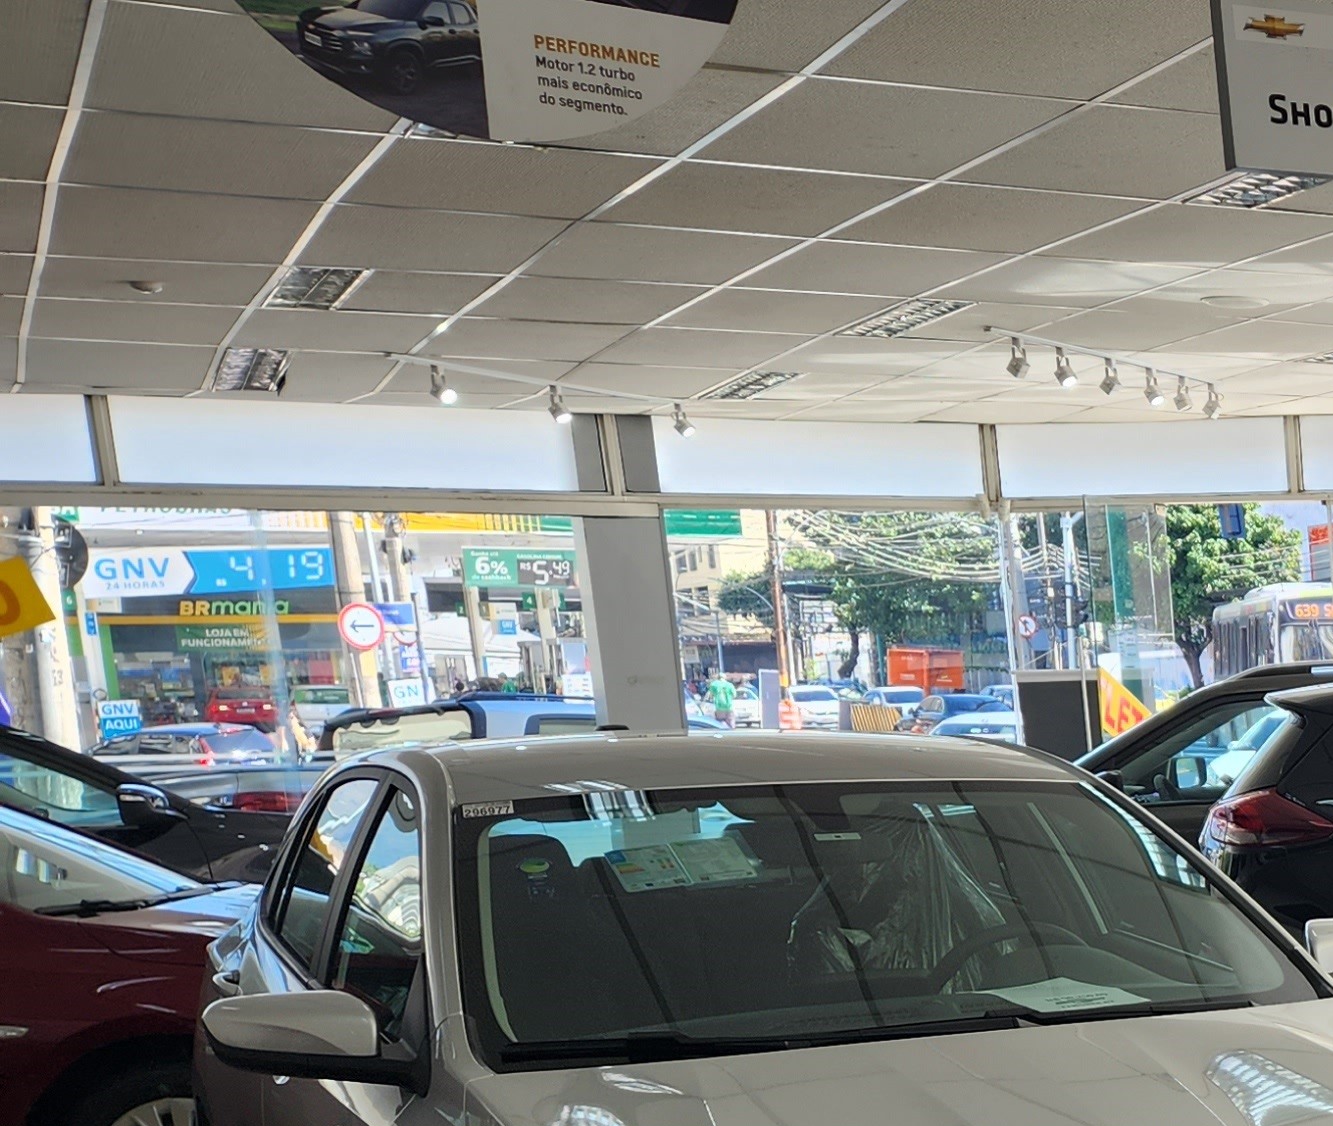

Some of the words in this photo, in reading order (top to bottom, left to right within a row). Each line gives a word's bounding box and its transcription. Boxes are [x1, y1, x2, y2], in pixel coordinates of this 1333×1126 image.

[533, 34, 660, 68] PERFORMANCE
[535, 55, 574, 72] Motor
[577, 61, 596, 76] 1.2
[599, 66, 635, 82] turbo
[537, 76, 568, 90] mais
[572, 83, 643, 100] econômico
[539, 92, 555, 106] do
[558, 97, 629, 116] segmento.
[94, 557, 170, 580] GNV
[475, 556, 509, 575] 6%
[105, 582, 121, 591] 24
[124, 581, 166, 590] HORAS
[1295, 603, 1319, 618] 639
[205, 628, 231, 637] LOJA
[102, 703, 134, 715] GNV
[105, 718, 138, 731] AQUI
